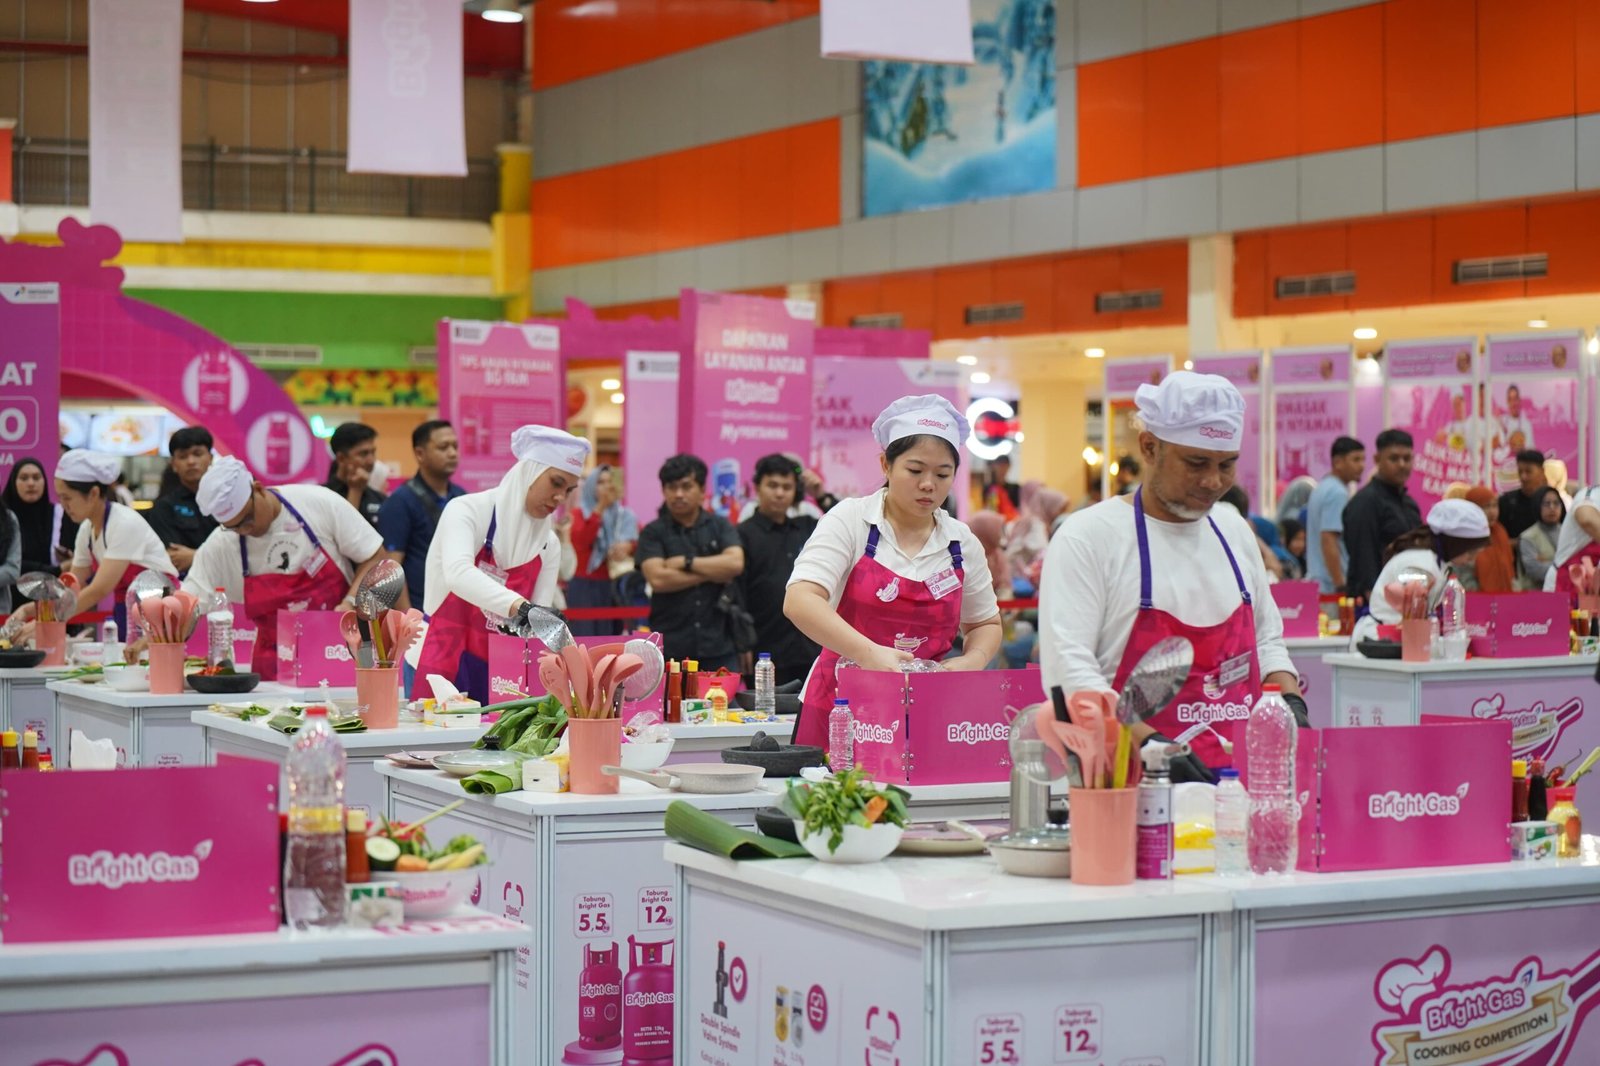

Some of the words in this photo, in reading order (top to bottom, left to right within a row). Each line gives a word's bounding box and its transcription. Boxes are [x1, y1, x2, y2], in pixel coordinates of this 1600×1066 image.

[326, 645, 353, 661] Brig
[1179, 703, 1222, 724] Bright
[1224, 703, 1248, 718] Gas
[853, 720, 873, 743] ight
[874, 728, 893, 742] Gas
[948, 722, 990, 744] Bright
[1370, 792, 1424, 818] Bright
[1426, 793, 1458, 814] Gas
[72, 857, 144, 884] Bright
[150, 856, 195, 877] Gas
[583, 896, 606, 904] Tabung
[641, 896, 660, 904] Bright
[646, 890, 668, 898] Tabung
[578, 902, 597, 910] Bright
[579, 913, 606, 932] 5,5
[645, 905, 667, 924] 12
[581, 984, 604, 998] Bright
[606, 984, 619, 995] Gas
[626, 993, 655, 1006] Bright
[656, 992, 674, 1003] Gas
[1065, 1008, 1092, 1018] Tabung
[1427, 997, 1487, 1031] Bright
[1488, 987, 1525, 1013] Gas
[986, 1017, 1014, 1027] Tabung
[1060, 1018, 1081, 1027] Bright
[1083, 1017, 1098, 1025] Gas
[980, 1027, 1004, 1036] Bright
[1005, 1026, 1020, 1034] Gas
[1413, 1040, 1471, 1060] COOKING
[1474, 1013, 1549, 1049] COMPETITION
[1063, 1029, 1089, 1053] 12
